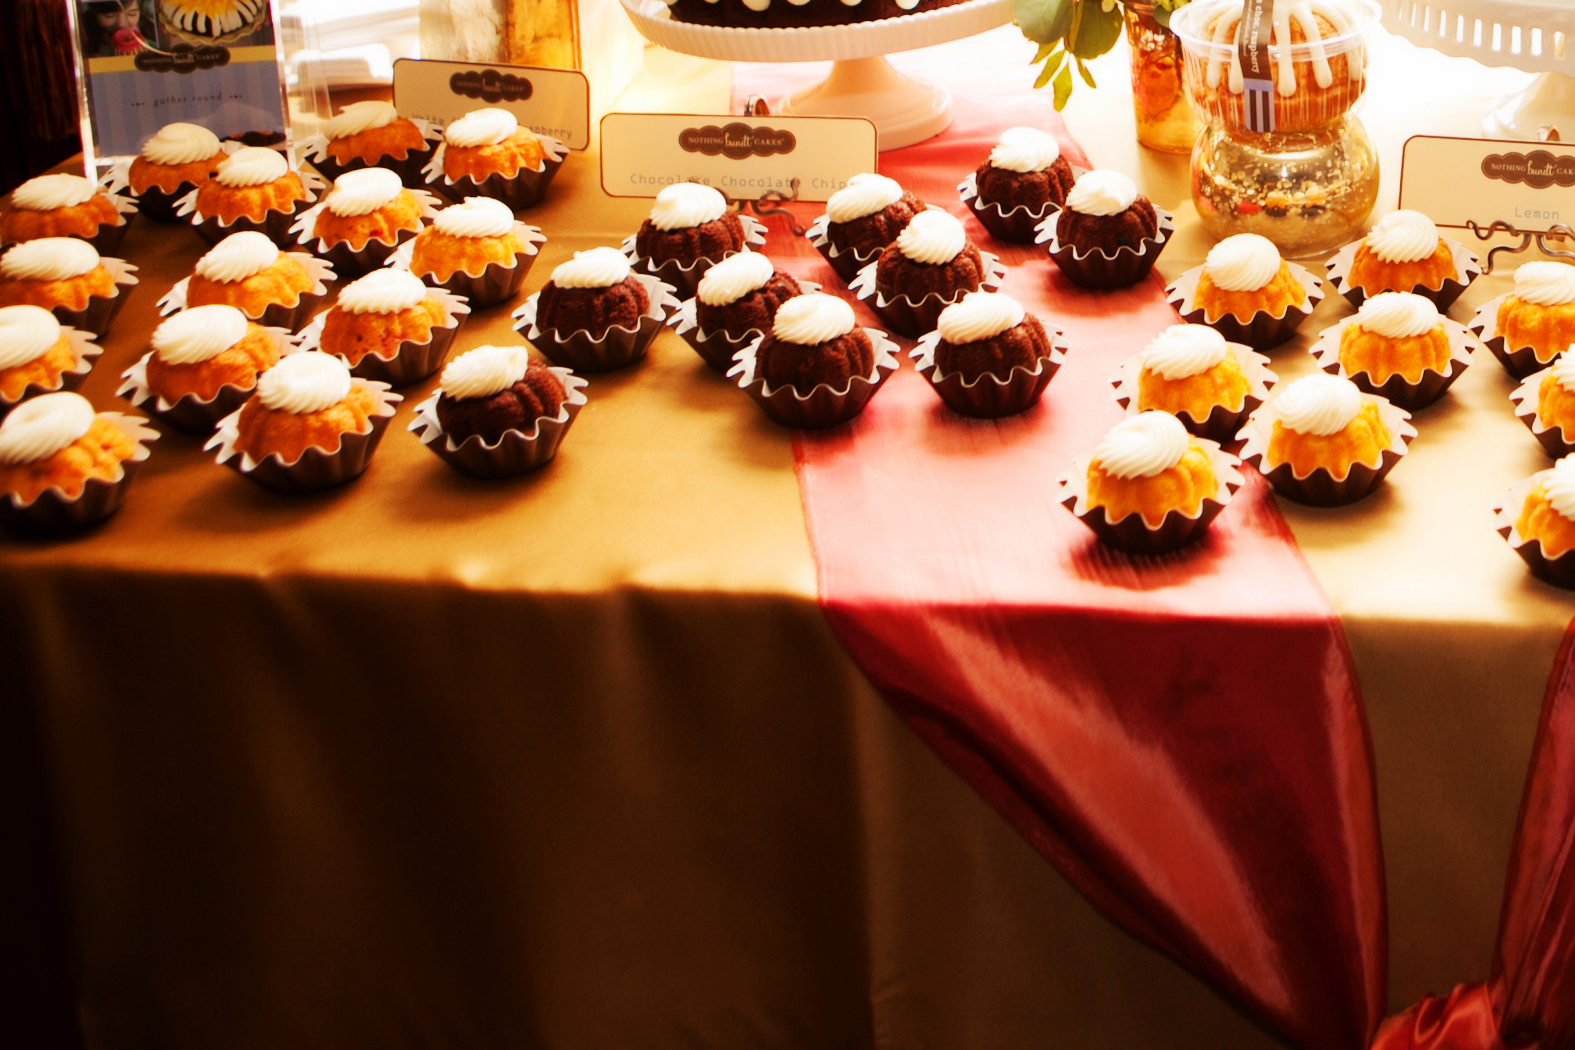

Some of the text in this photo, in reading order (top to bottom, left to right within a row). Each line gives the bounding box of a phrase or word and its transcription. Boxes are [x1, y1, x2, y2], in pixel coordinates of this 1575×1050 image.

[1253, 5, 1263, 29] choc.
[1248, 30, 1260, 74] raspberry
[154, 92, 222, 108] gather round
[524, 124, 573, 140] spberry
[688, 136, 724, 144] NOTHING
[725, 133, 754, 147] bundt
[1490, 163, 1527, 172] NOTHING
[1527, 160, 1557, 176] bundt
[1514, 206, 1560, 220] Lemon
